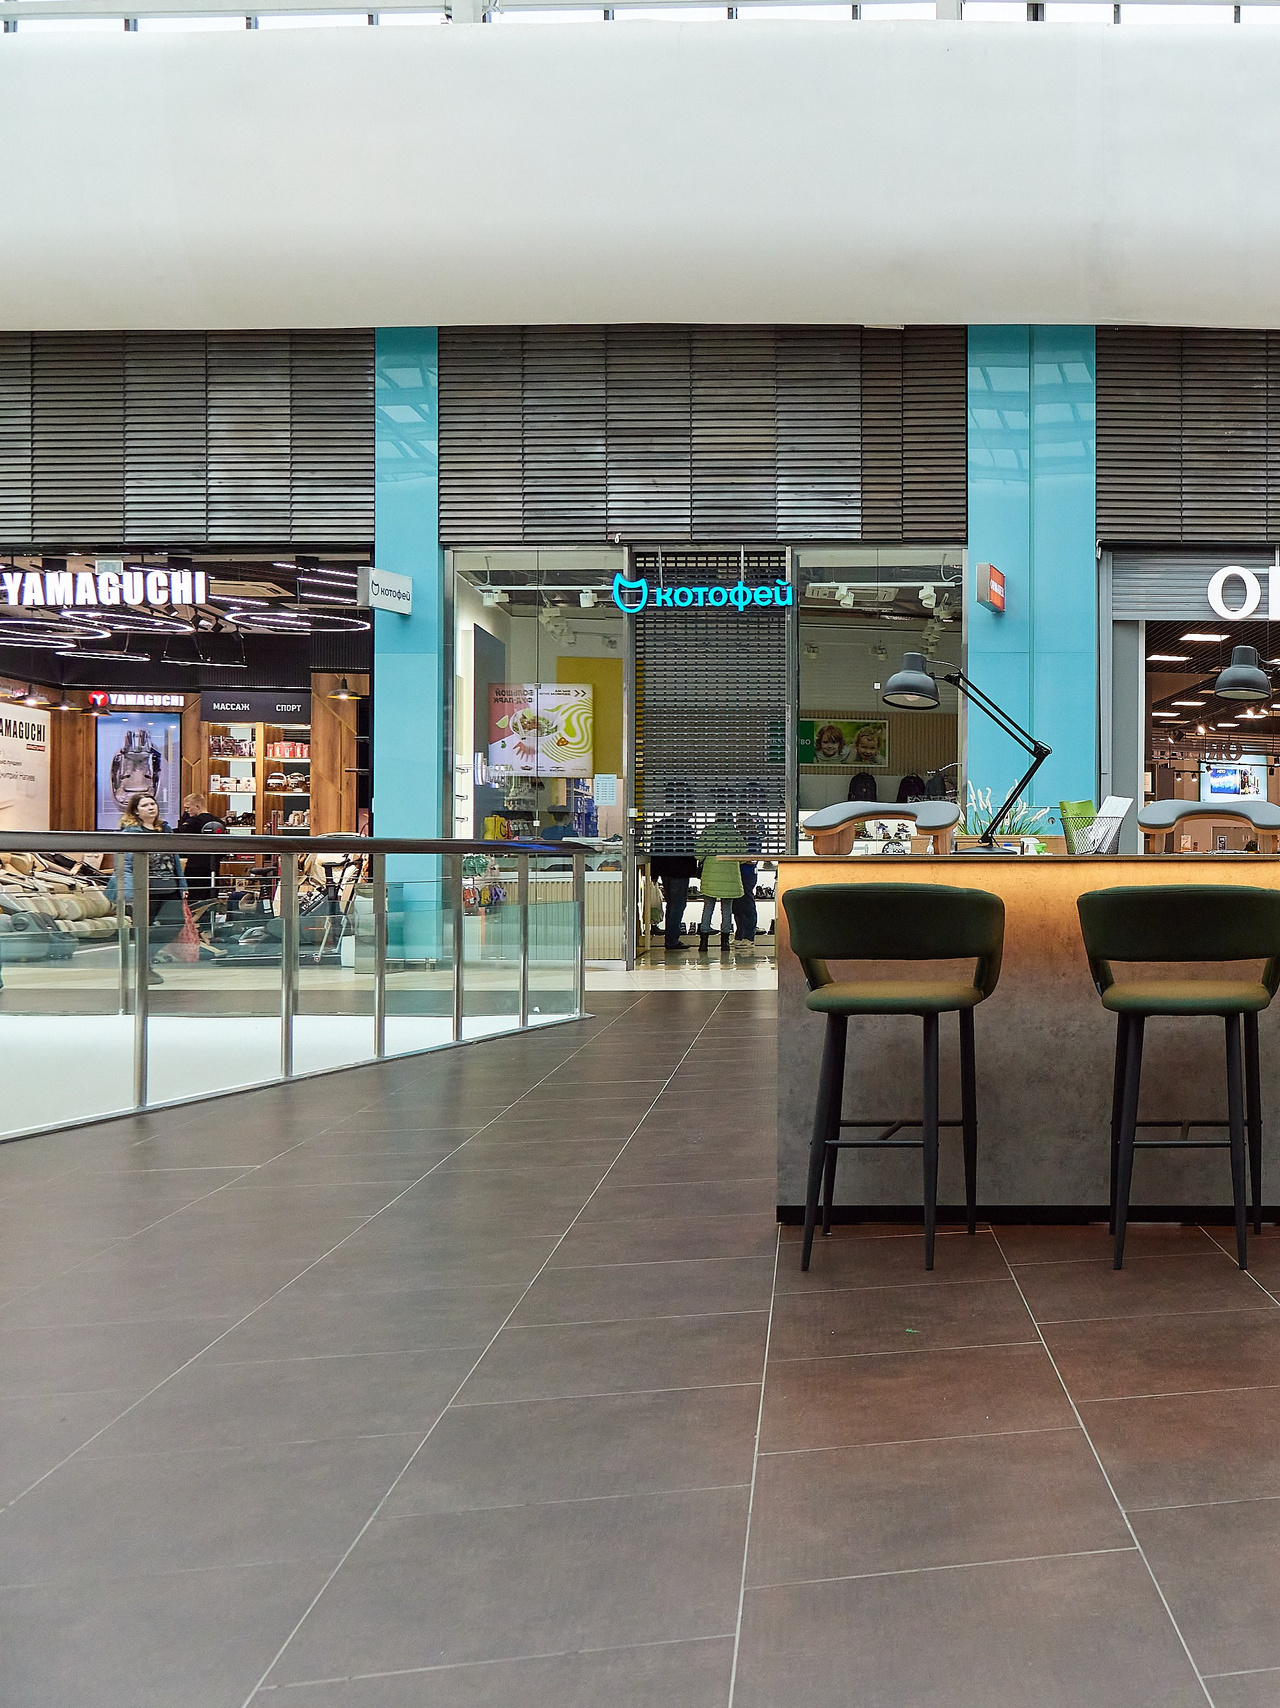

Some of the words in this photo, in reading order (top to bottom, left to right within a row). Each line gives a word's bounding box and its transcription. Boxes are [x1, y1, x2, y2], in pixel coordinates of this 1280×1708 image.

[1, 572, 207, 605] YAMAGUCHI
[656, 578, 793, 612] котофей
[109, 693, 185, 707] YAMAGUCHI
[213, 702, 251, 711] МАССАЖ
[275, 704, 302, 712] СПОРТ
